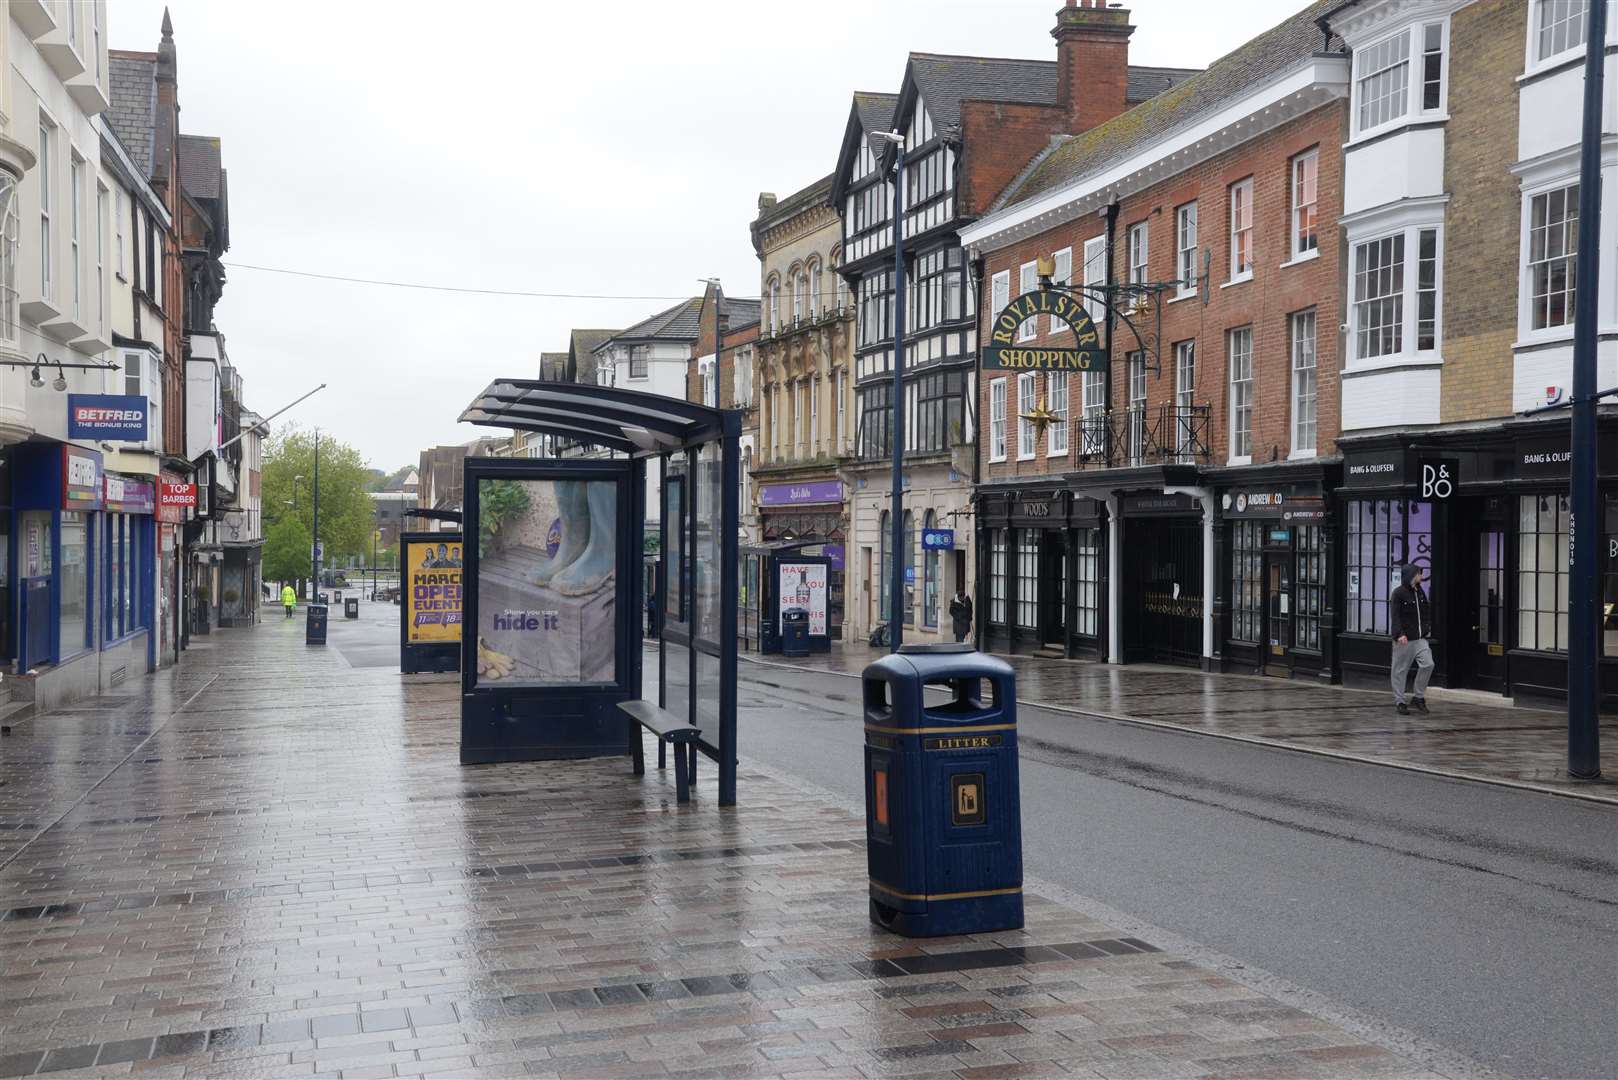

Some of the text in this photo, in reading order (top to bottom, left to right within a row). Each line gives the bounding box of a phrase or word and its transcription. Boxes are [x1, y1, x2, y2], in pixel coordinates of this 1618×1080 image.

[994, 293, 1096, 346] ROYAL STAR
[999, 349, 1090, 368] SHOPPING
[78, 409, 143, 420] BETFRED
[1524, 454, 1544, 463] BANG
[1546, 454, 1551, 462] &
[1350, 466, 1365, 474] BANG
[1370, 464, 1394, 473] OLUFSEN
[169, 484, 189, 493] TOP
[162, 495, 195, 503] BARBER
[1024, 503, 1048, 516] WOODS
[414, 574, 462, 585] MARC
[414, 585, 462, 600] OPE
[493, 614, 560, 631] hide it
[939, 738, 989, 749] LITTER
